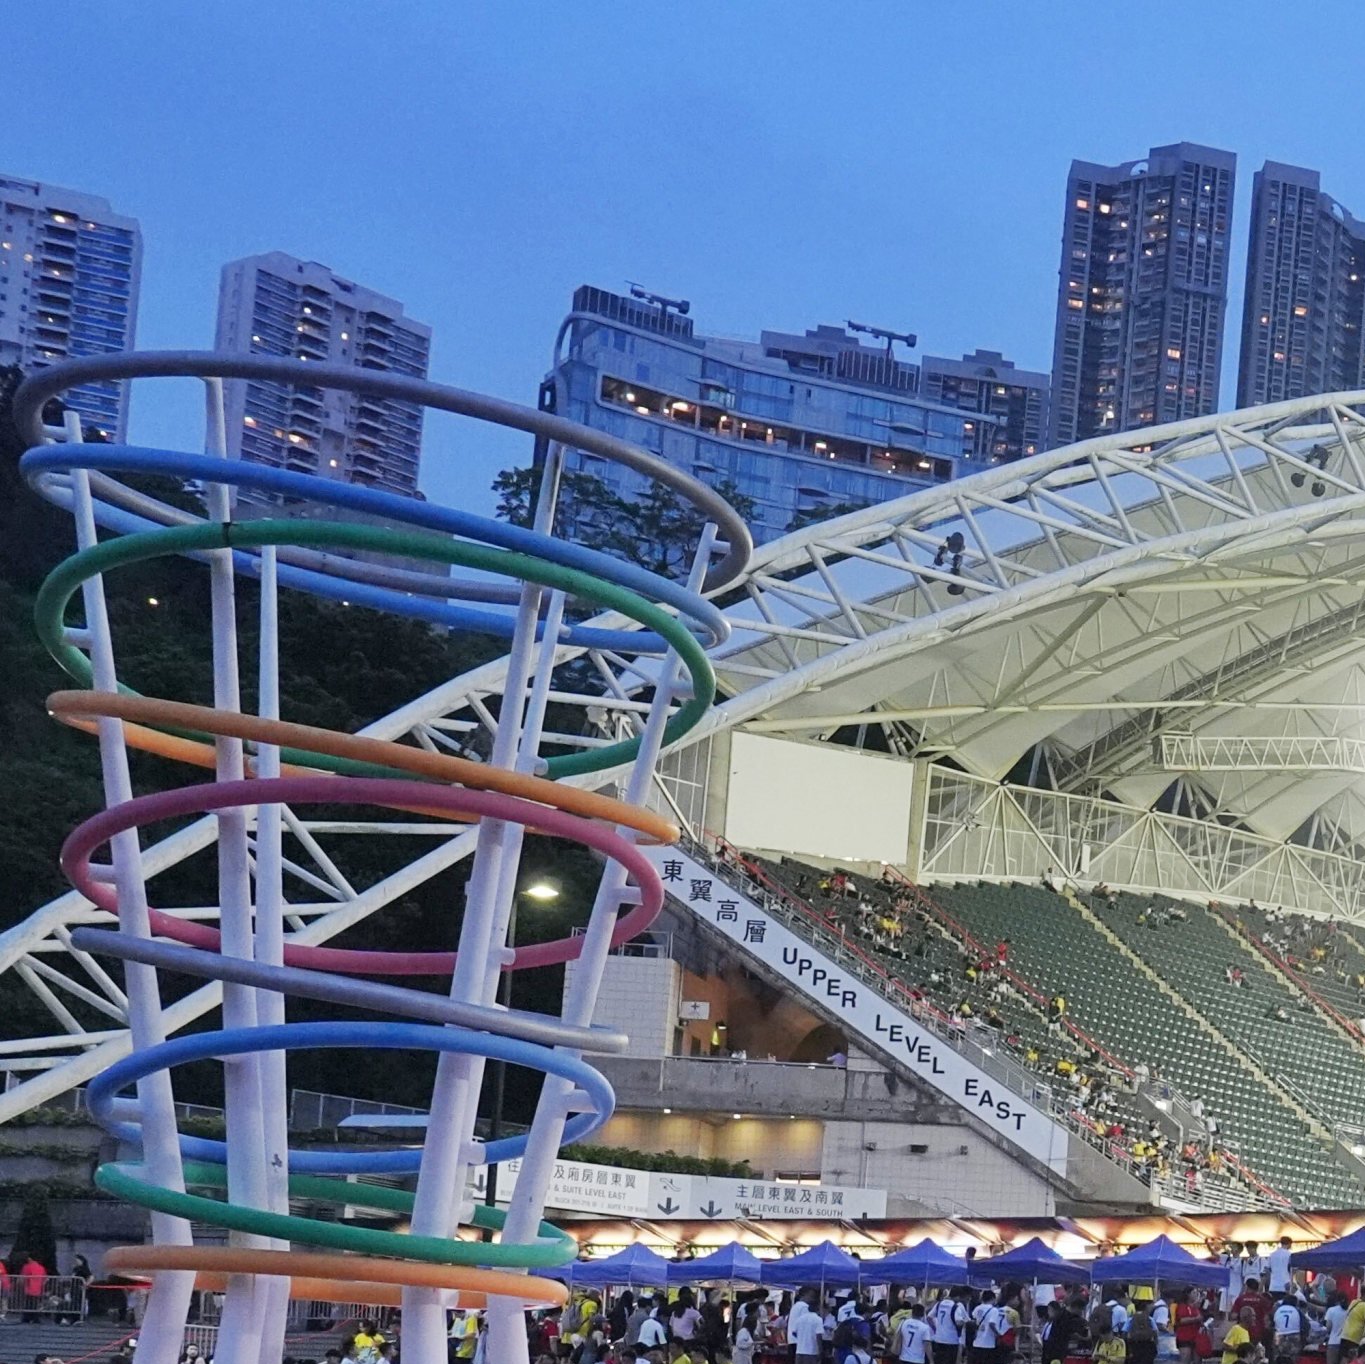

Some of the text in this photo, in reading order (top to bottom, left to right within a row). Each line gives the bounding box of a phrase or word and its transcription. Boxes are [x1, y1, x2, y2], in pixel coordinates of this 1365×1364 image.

[661, 859, 766, 943] 東翼高層
[782, 947, 1026, 1130] UPPER LEVEL EAST
[562, 1186, 582, 1195] SUITE
[585, 1188, 606, 1198] LEVEL
[608, 1190, 627, 1200] EAST
[736, 1185, 844, 1206] 主層東翼及南翼
[758, 1205, 780, 1214] LEVEL
[784, 1206, 804, 1216] EAST
[816, 1208, 843, 1218] SOUTH
[1283, 1315, 1290, 1329] 7
[908, 1331, 915, 1348] 7
